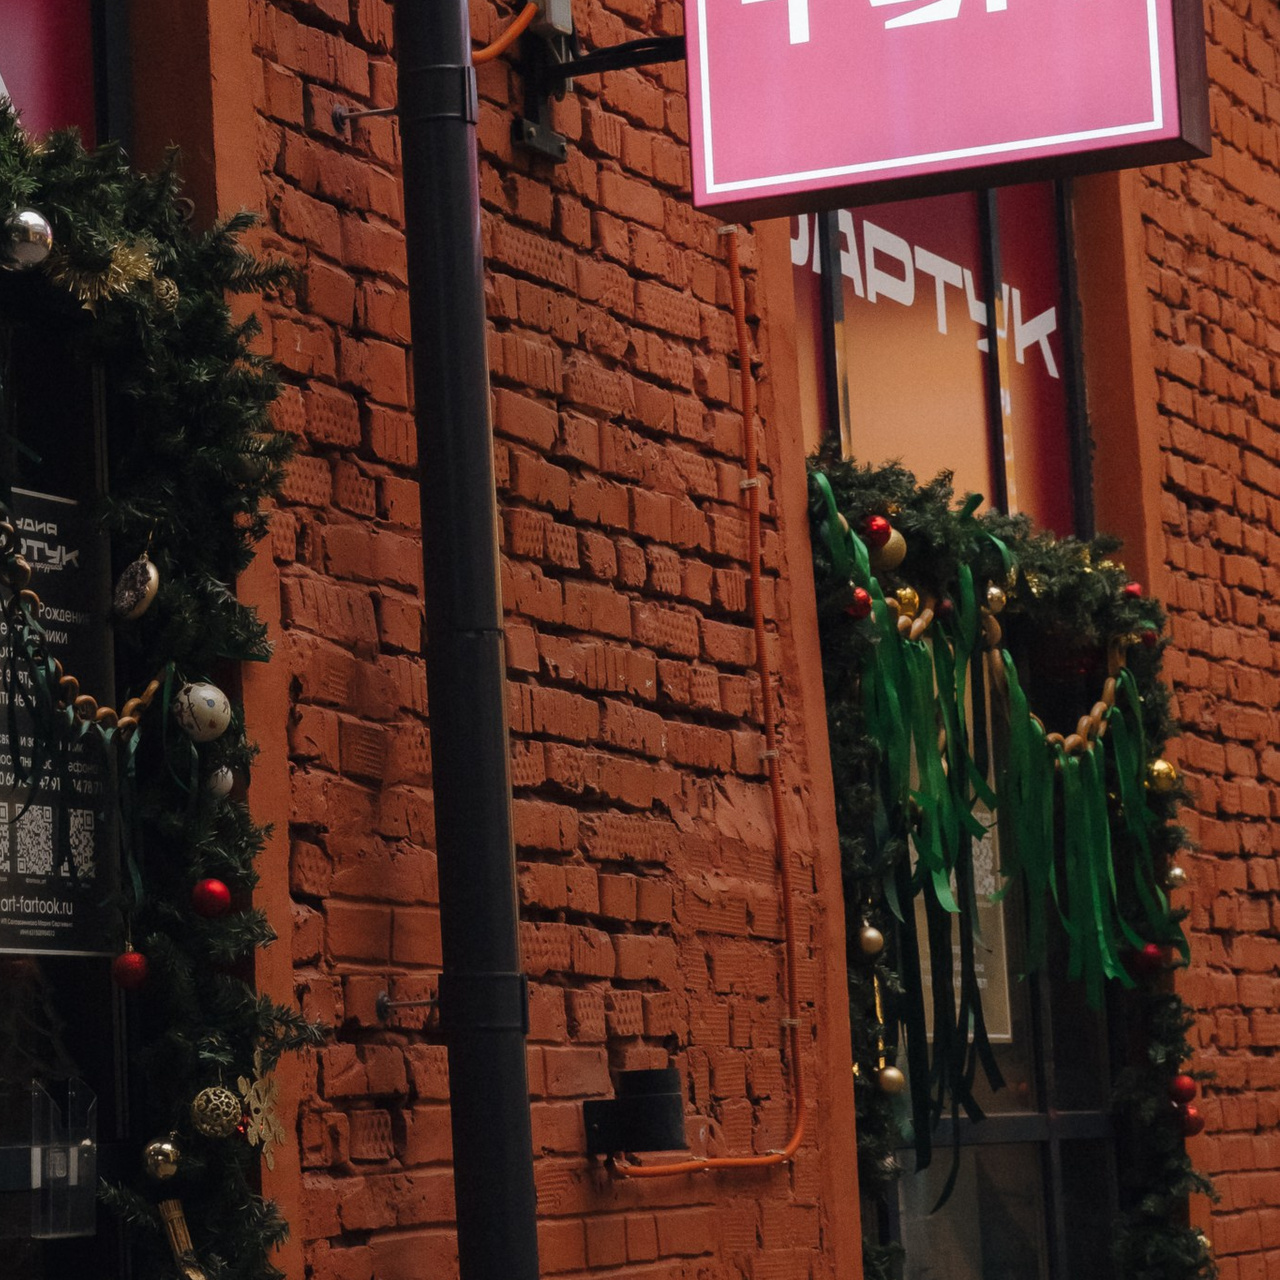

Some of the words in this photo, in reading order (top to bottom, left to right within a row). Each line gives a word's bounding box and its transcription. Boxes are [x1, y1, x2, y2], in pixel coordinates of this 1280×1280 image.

[789, 207, 1060, 380] АРТУК
[38, 601, 88, 624] Рождени
[0, 895, 73, 915] art-fartook.ru
